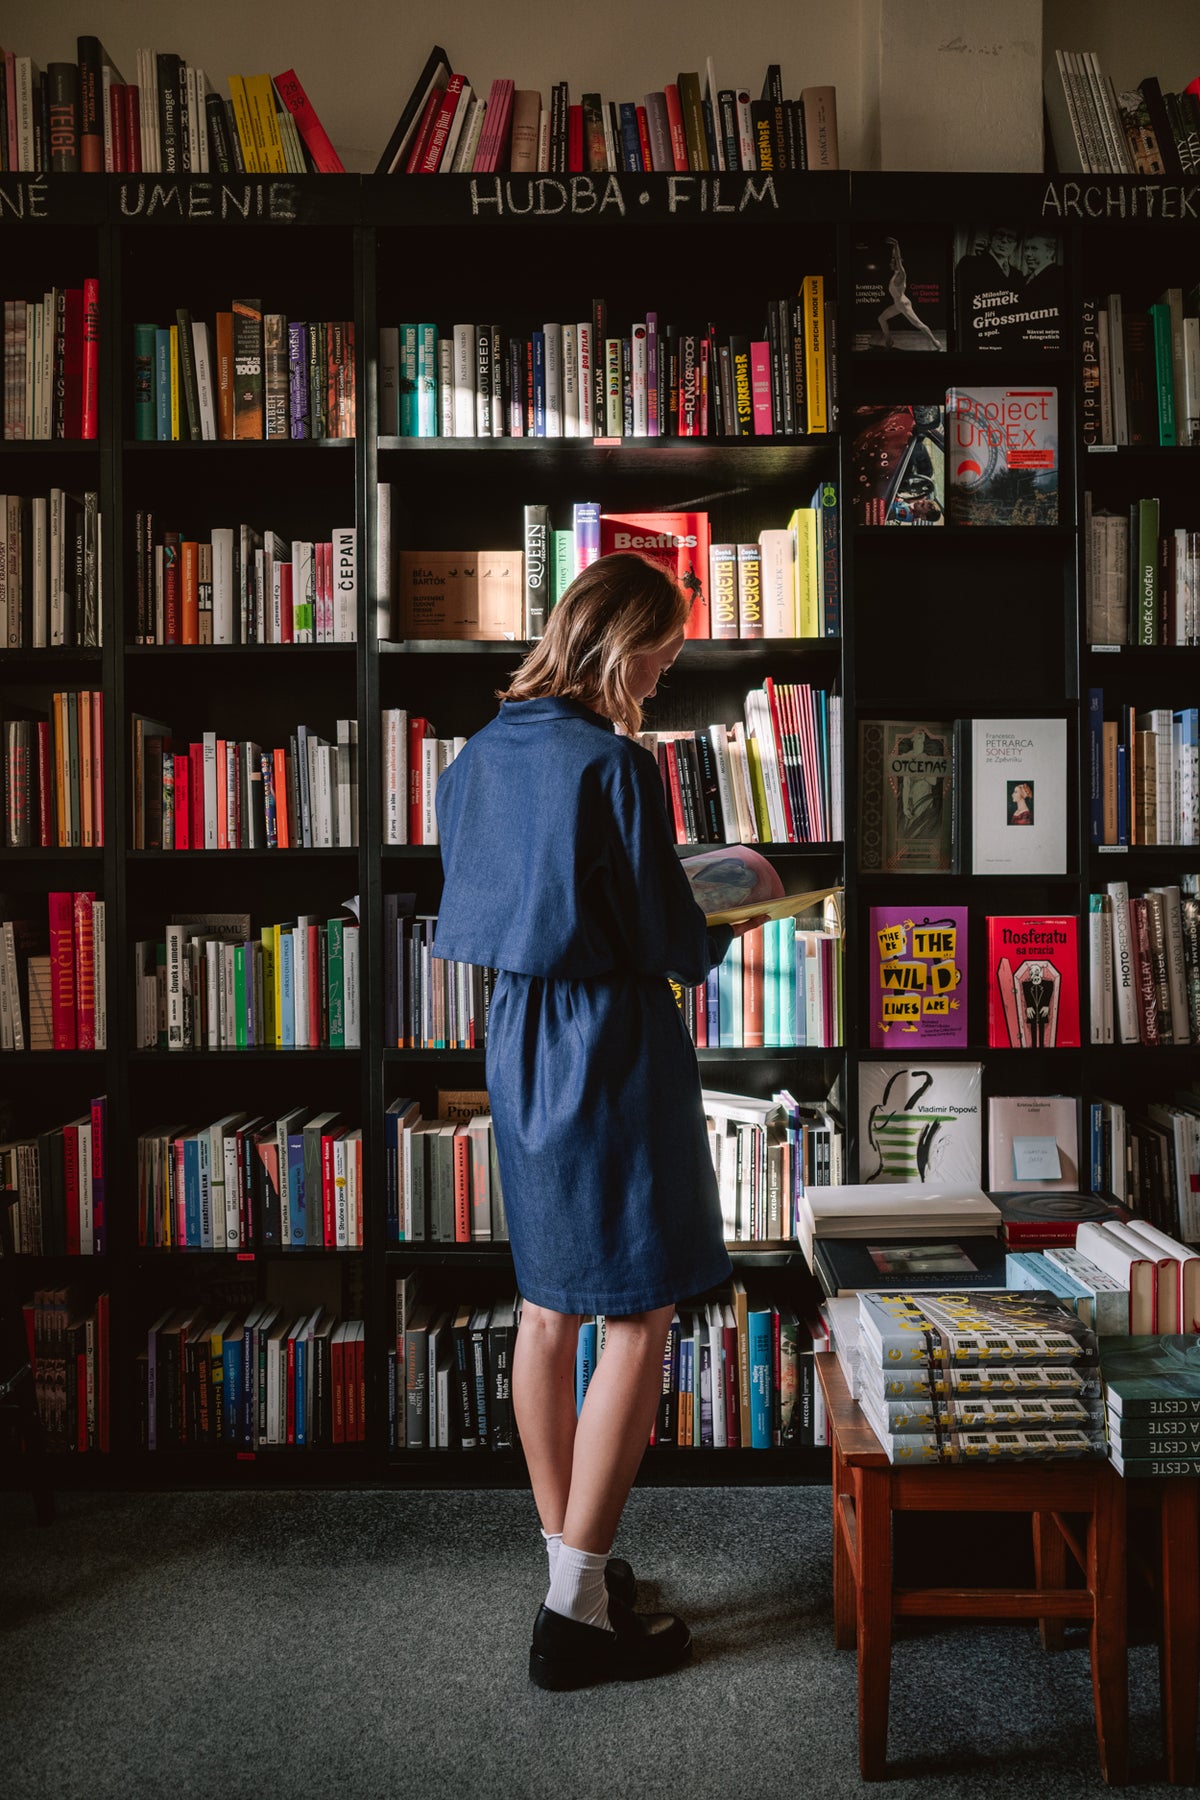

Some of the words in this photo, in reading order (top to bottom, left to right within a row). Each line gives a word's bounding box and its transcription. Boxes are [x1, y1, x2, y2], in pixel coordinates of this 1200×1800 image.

[50, 104, 75, 156] TEIGE
[424, 145, 439, 171] Máme
[119, 182, 297, 219] UMENIE
[469, 176, 625, 215] HUDBA
[669, 175, 780, 214] FILM
[1042, 181, 1200, 218] ARCHITEK
[973, 307, 1059, 329] Grossmann
[289, 328, 299, 359] UMĚNÍ
[406, 329, 416, 352] STONES
[425, 328, 434, 352] STONES
[479, 337, 488, 374] REED
[685, 336, 694, 380] PARADOX
[794, 337, 803, 382] FIGHTERS
[480, 377, 489, 401] LOU
[610, 377, 618, 395] BOB
[685, 380, 695, 411] PUNK
[735, 353, 752, 415] SURRENDER
[276, 395, 285, 433] UMĚNÍ
[956, 397, 1049, 425] Project
[957, 423, 1037, 447] UrbEx
[559, 535, 567, 563] TEXTY
[614, 532, 697, 548] Beatles
[338, 535, 354, 591] ČEPAN
[527, 525, 544, 588] QUEEN
[715, 561, 734, 621] OPERETA
[741, 560, 760, 621] OPERETA
[825, 548, 837, 606] HUDBA
[1143, 565, 1153, 607] ČLOVĚKU
[1143, 609, 1153, 645] ČLOVĚK
[986, 739, 1033, 748] PETRARCA
[986, 748, 1023, 756] SONETY
[170, 935, 178, 963] umenie
[915, 933, 954, 952] THE
[1002, 929, 1067, 945] Nosferatu
[1016, 947, 1026, 955] sa
[1115, 892, 1131, 987] PHOTOREPORTING
[51, 929, 74, 1008] umění
[1141, 961, 1154, 1000] KÁLLAY
[949, 1106, 977, 1114] Popovič
[888, 1347, 1082, 1361] CVERNOVKA
[461, 1381, 469, 1410] NEWMAN
[475, 1377, 486, 1414] MOTHER
[1150, 1401, 1187, 1413] CESTE
[478, 1416, 487, 1435] BAD
[1148, 1422, 1186, 1433] CESTE
[1150, 1442, 1188, 1453] CESTE
[1152, 1462, 1189, 1473] CESTE
